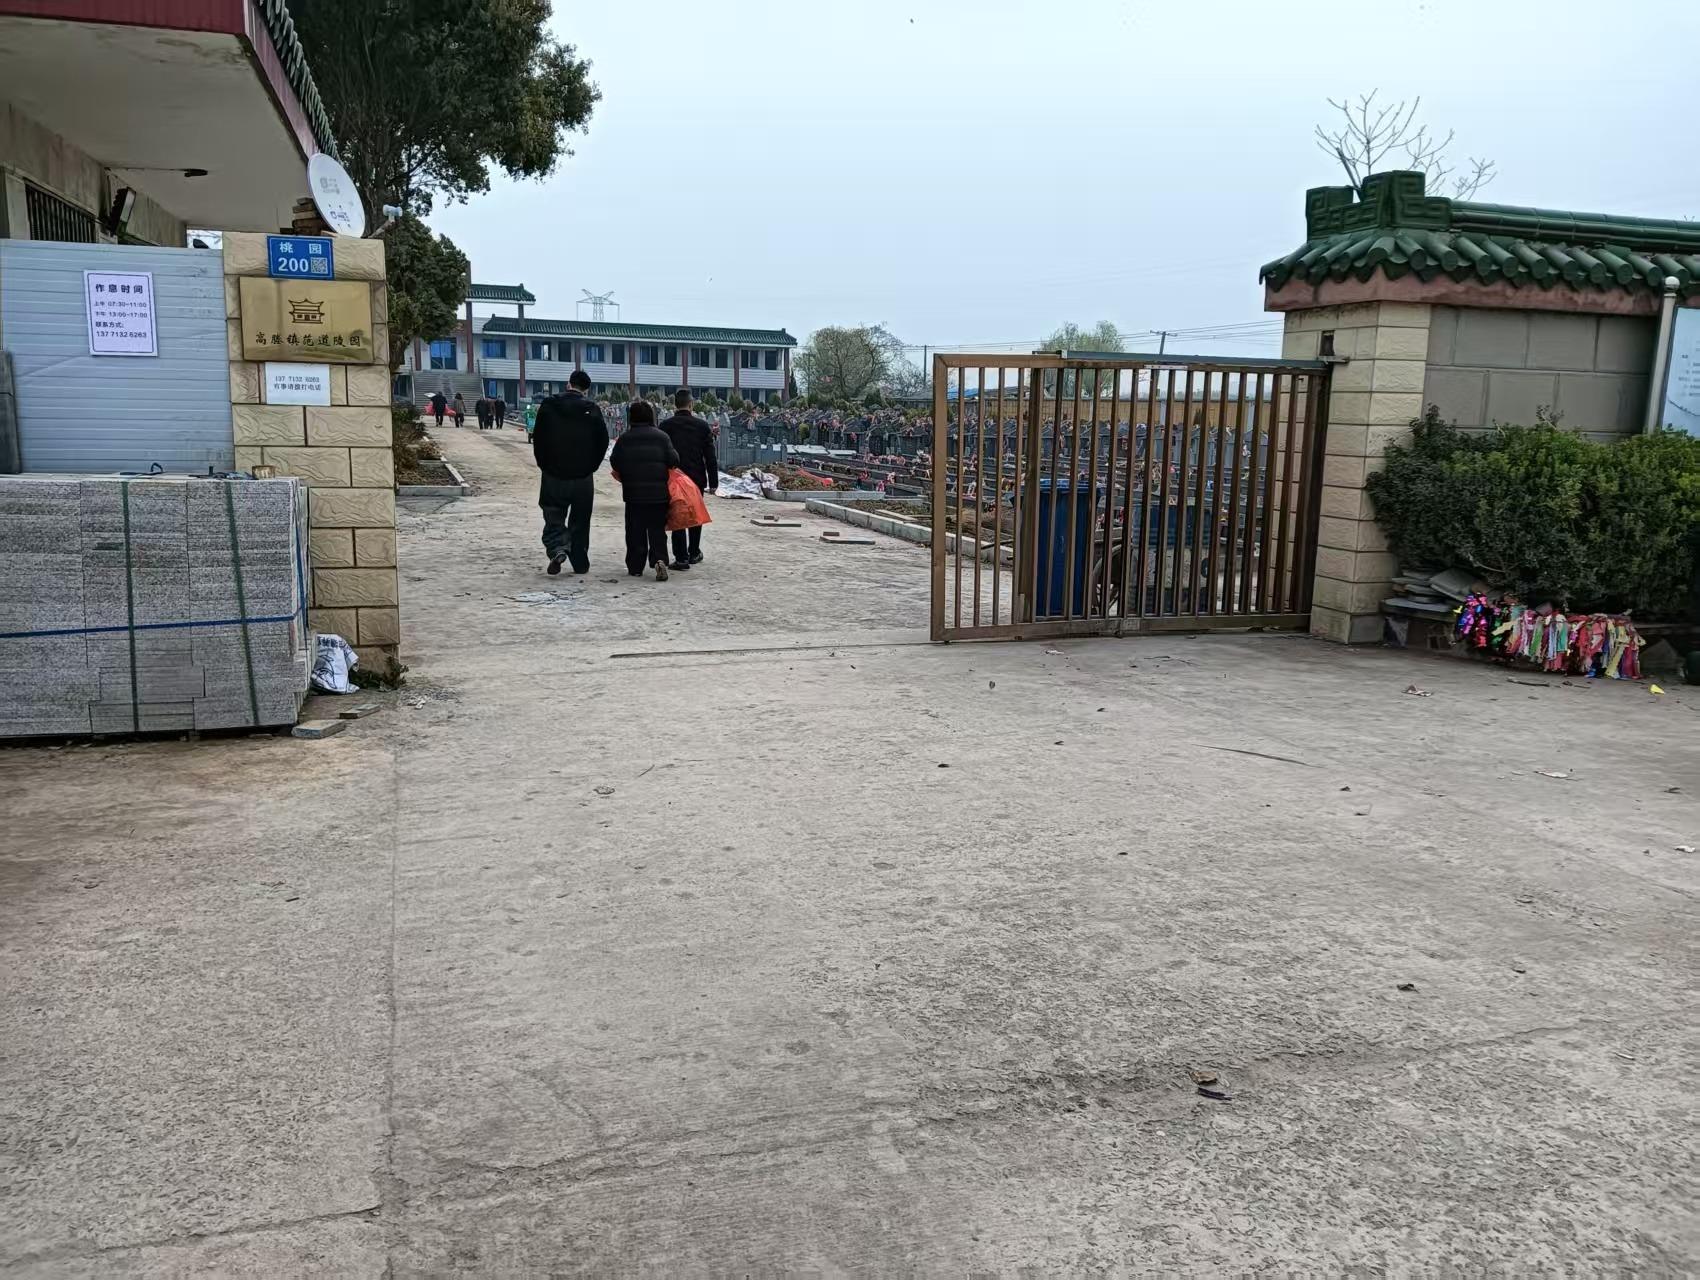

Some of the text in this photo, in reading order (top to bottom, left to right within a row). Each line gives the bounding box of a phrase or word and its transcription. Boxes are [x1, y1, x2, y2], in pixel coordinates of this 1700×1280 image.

[280, 242, 321, 254] 桃园
[278, 257, 309, 272] 200
[95, 283, 143, 294] 作息时间
